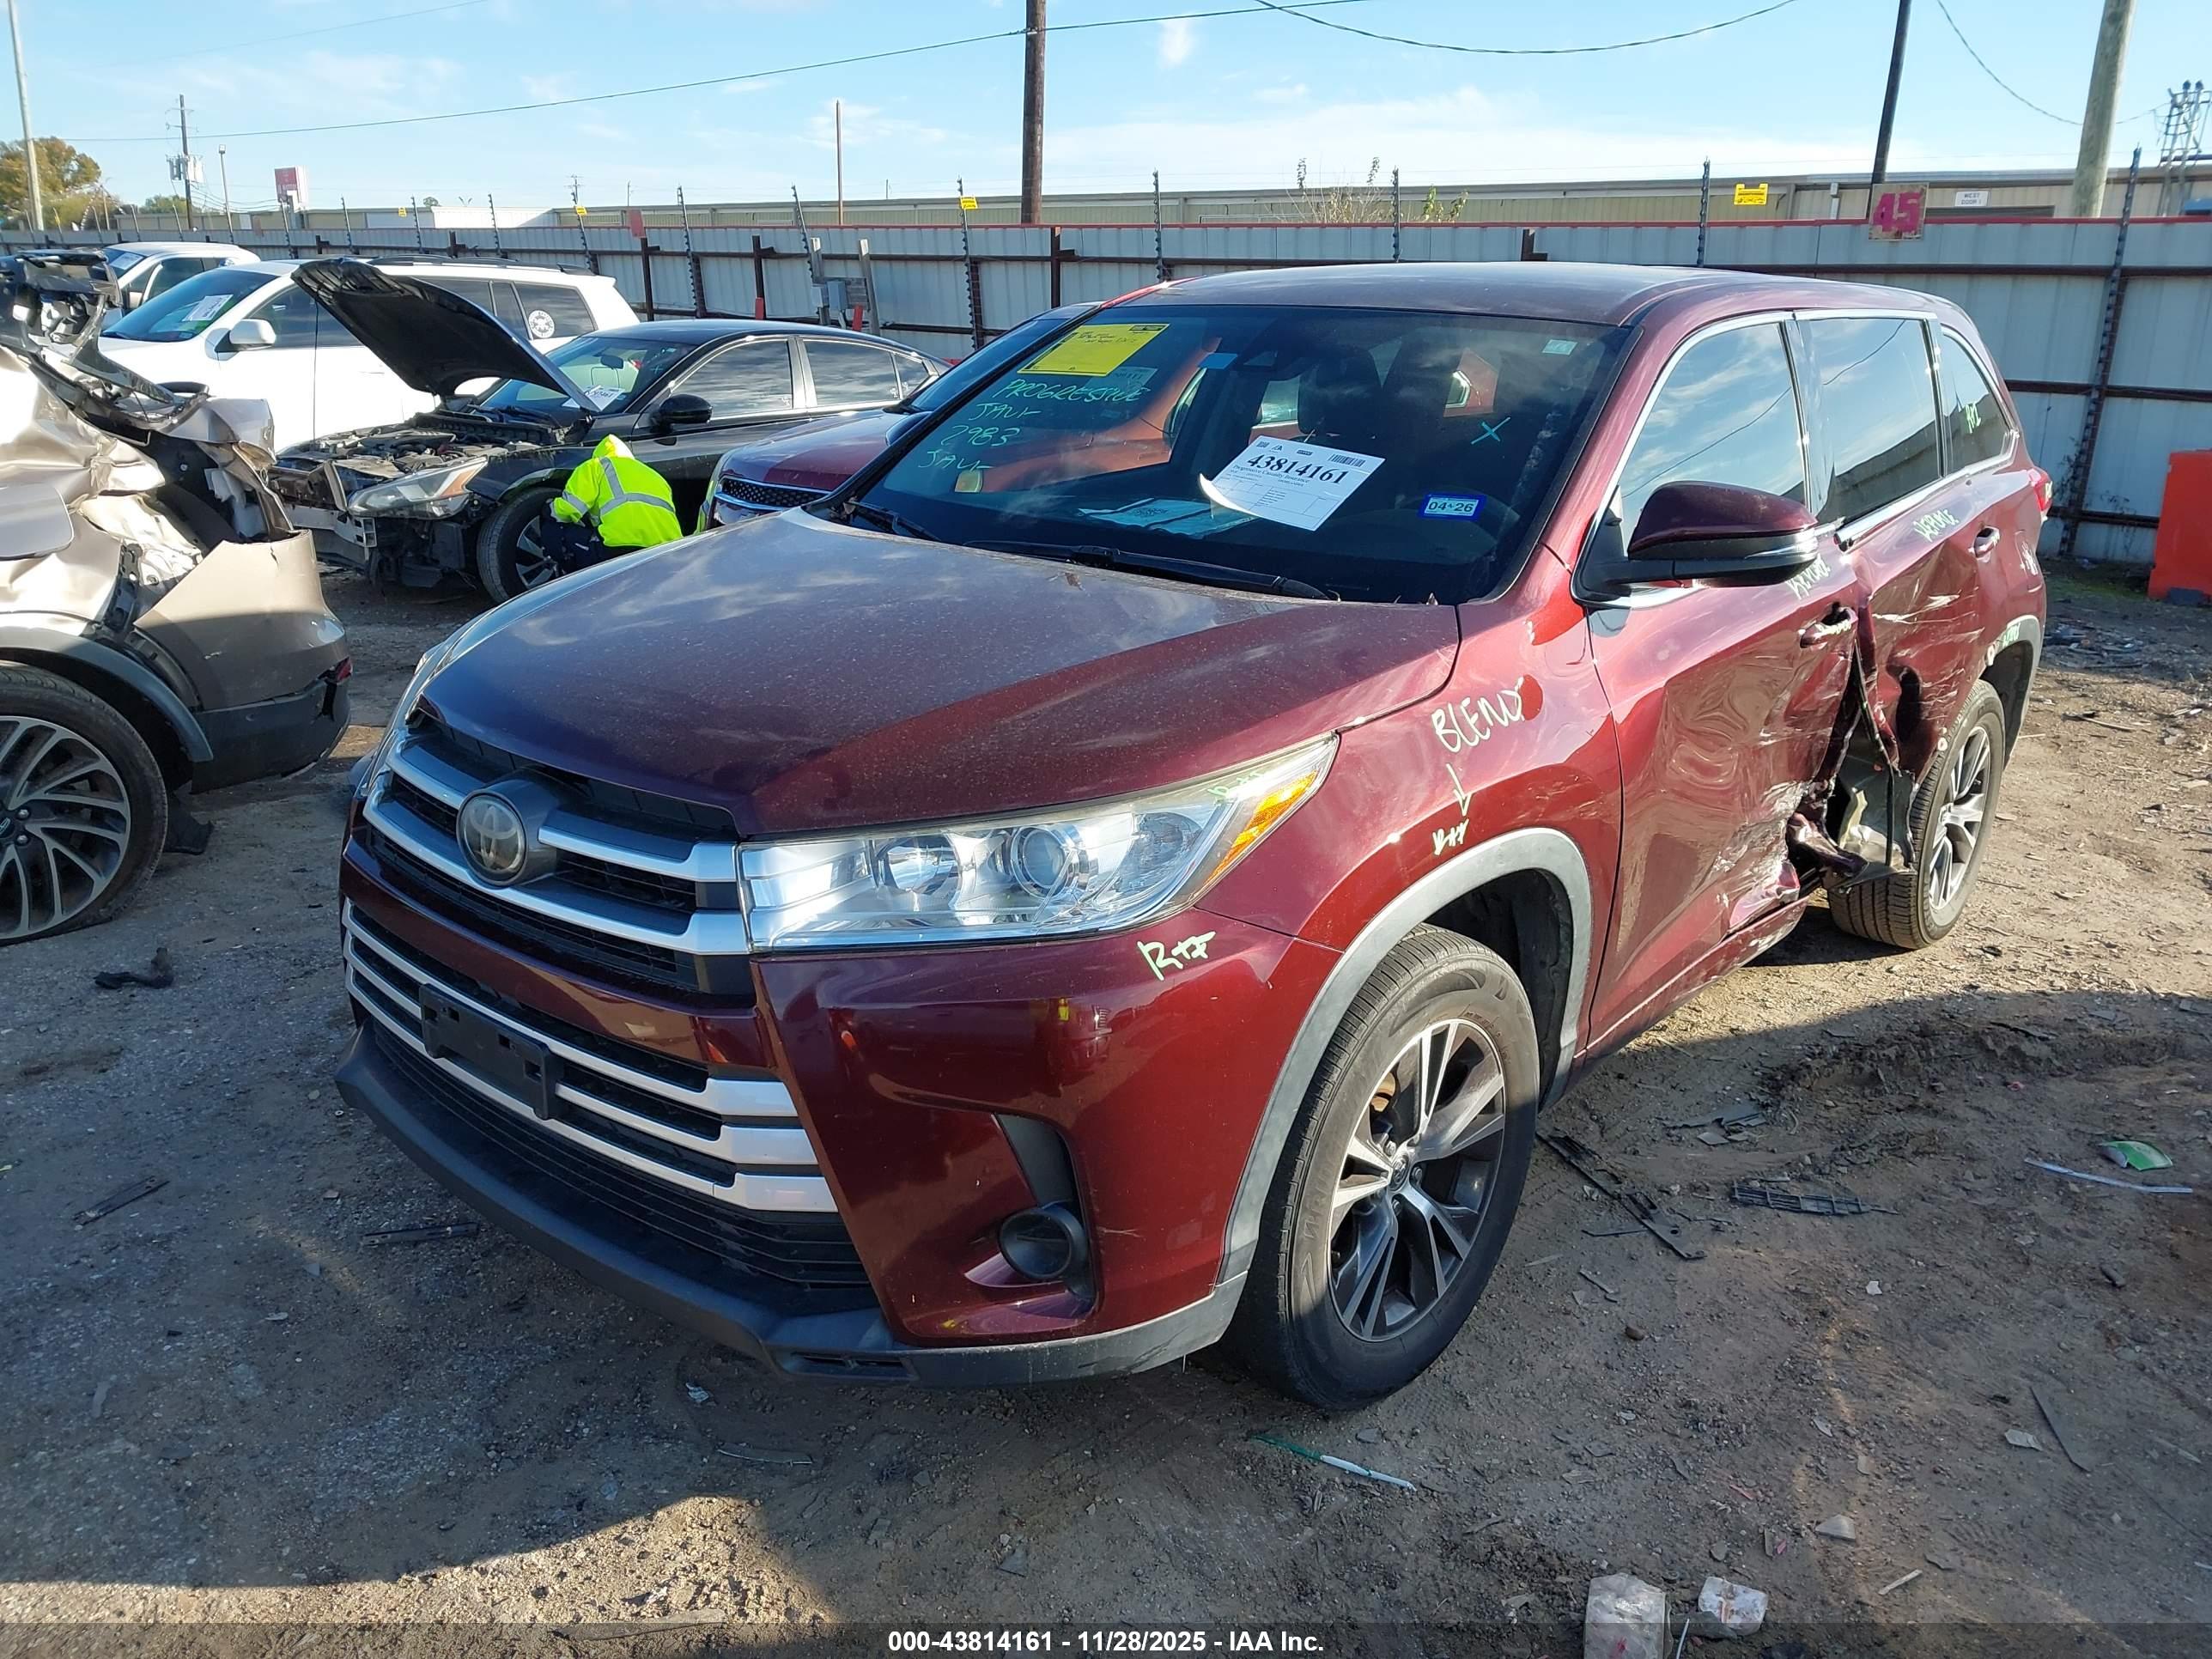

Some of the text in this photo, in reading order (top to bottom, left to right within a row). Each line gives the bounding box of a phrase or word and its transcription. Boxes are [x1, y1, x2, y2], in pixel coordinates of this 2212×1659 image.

[1872, 191, 1921, 233] 45
[1247, 454, 1349, 484] 43814161
[1428, 501, 1474, 512] 04 26
